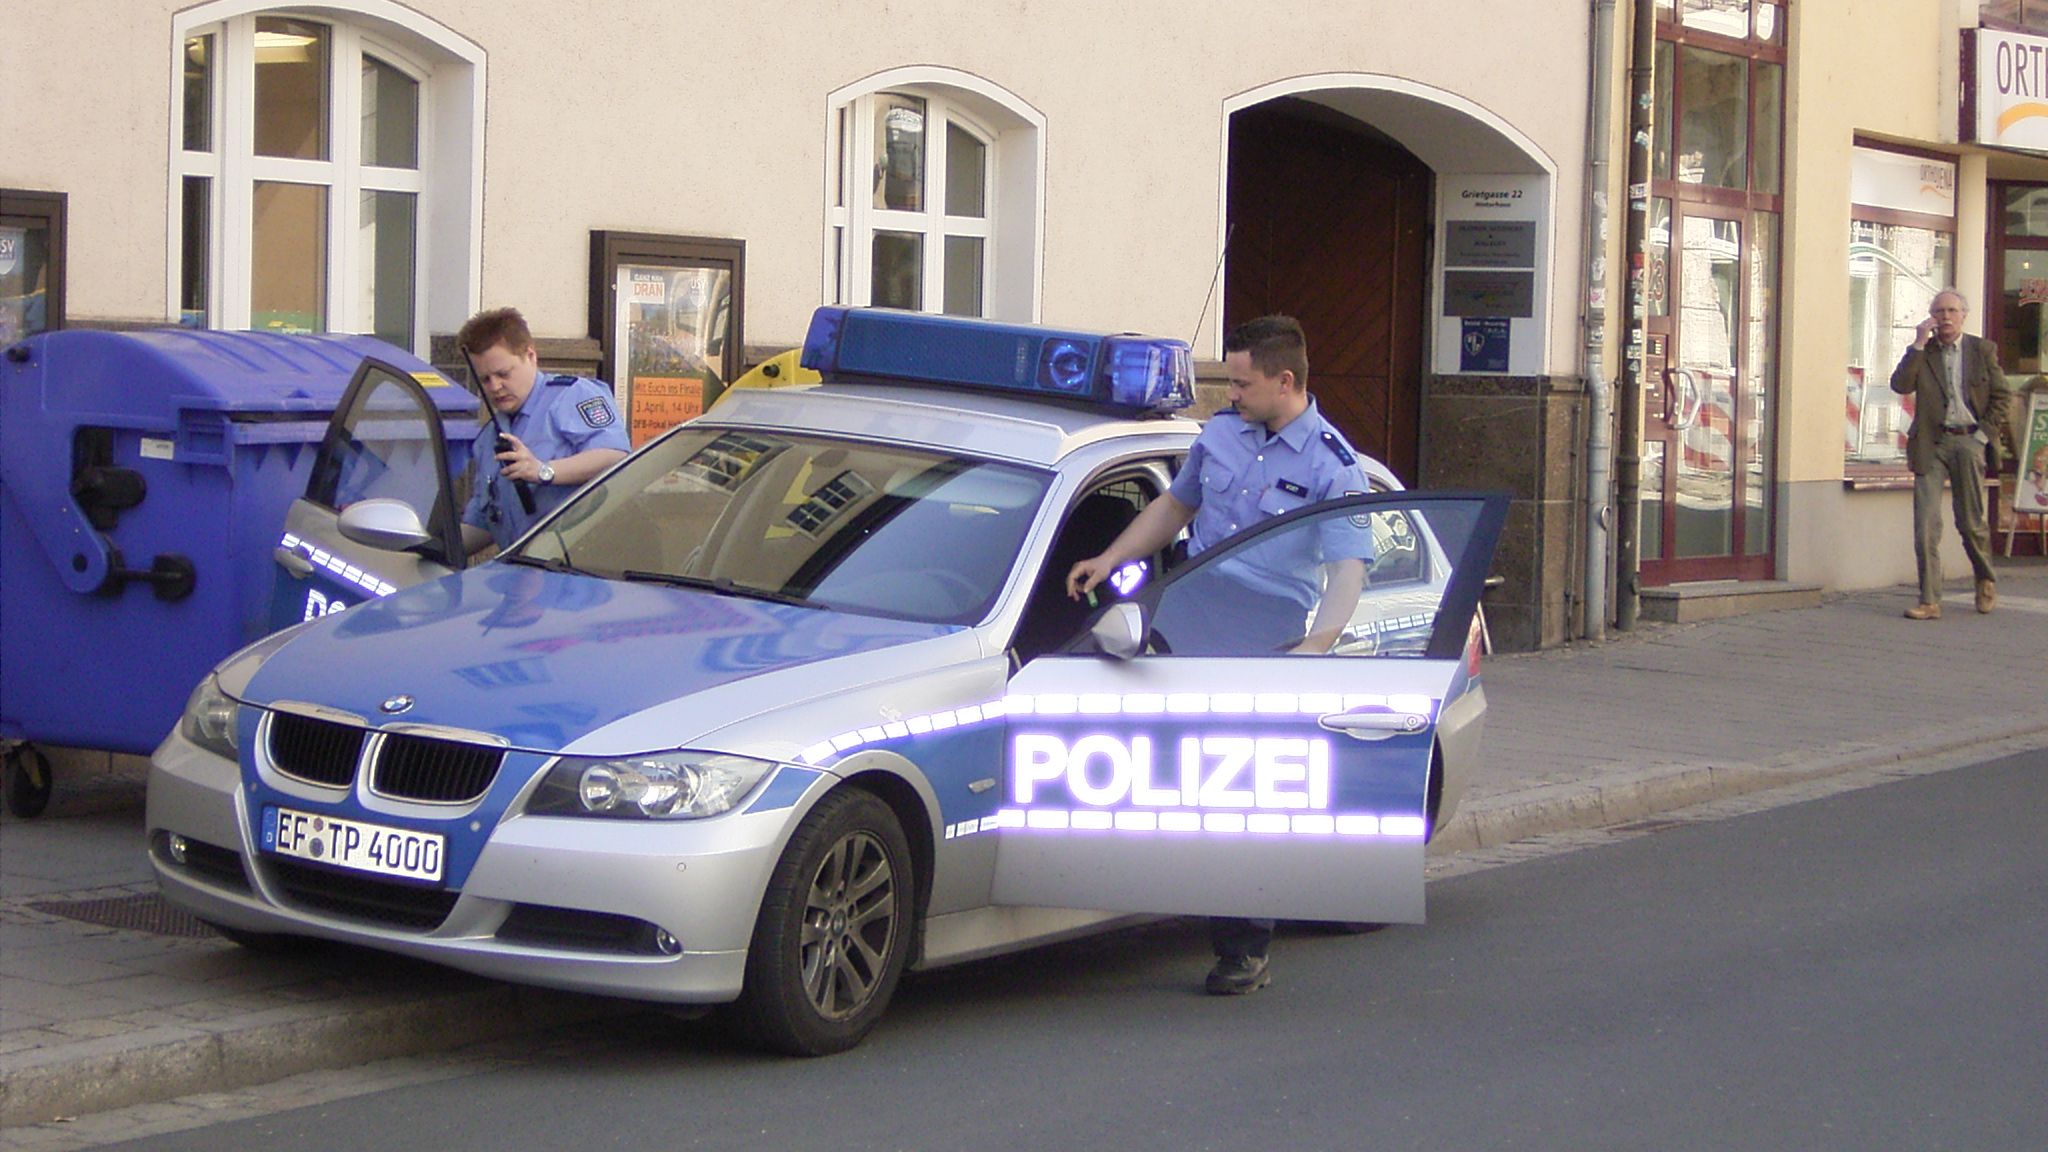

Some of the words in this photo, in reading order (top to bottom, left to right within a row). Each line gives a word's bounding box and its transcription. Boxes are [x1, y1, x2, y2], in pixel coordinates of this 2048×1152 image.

[1461, 189, 1510, 200] Grietgasse
[1511, 189, 1523, 198] 22
[634, 283, 663, 297] DRAN
[648, 382, 666, 393] Euch
[672, 402, 681, 412] 14
[684, 402, 699, 414] Uhr
[1014, 734, 1329, 809] POLIZEI
[279, 813, 308, 851] EF
[328, 822, 360, 861] TP
[368, 831, 439, 874] 4000
